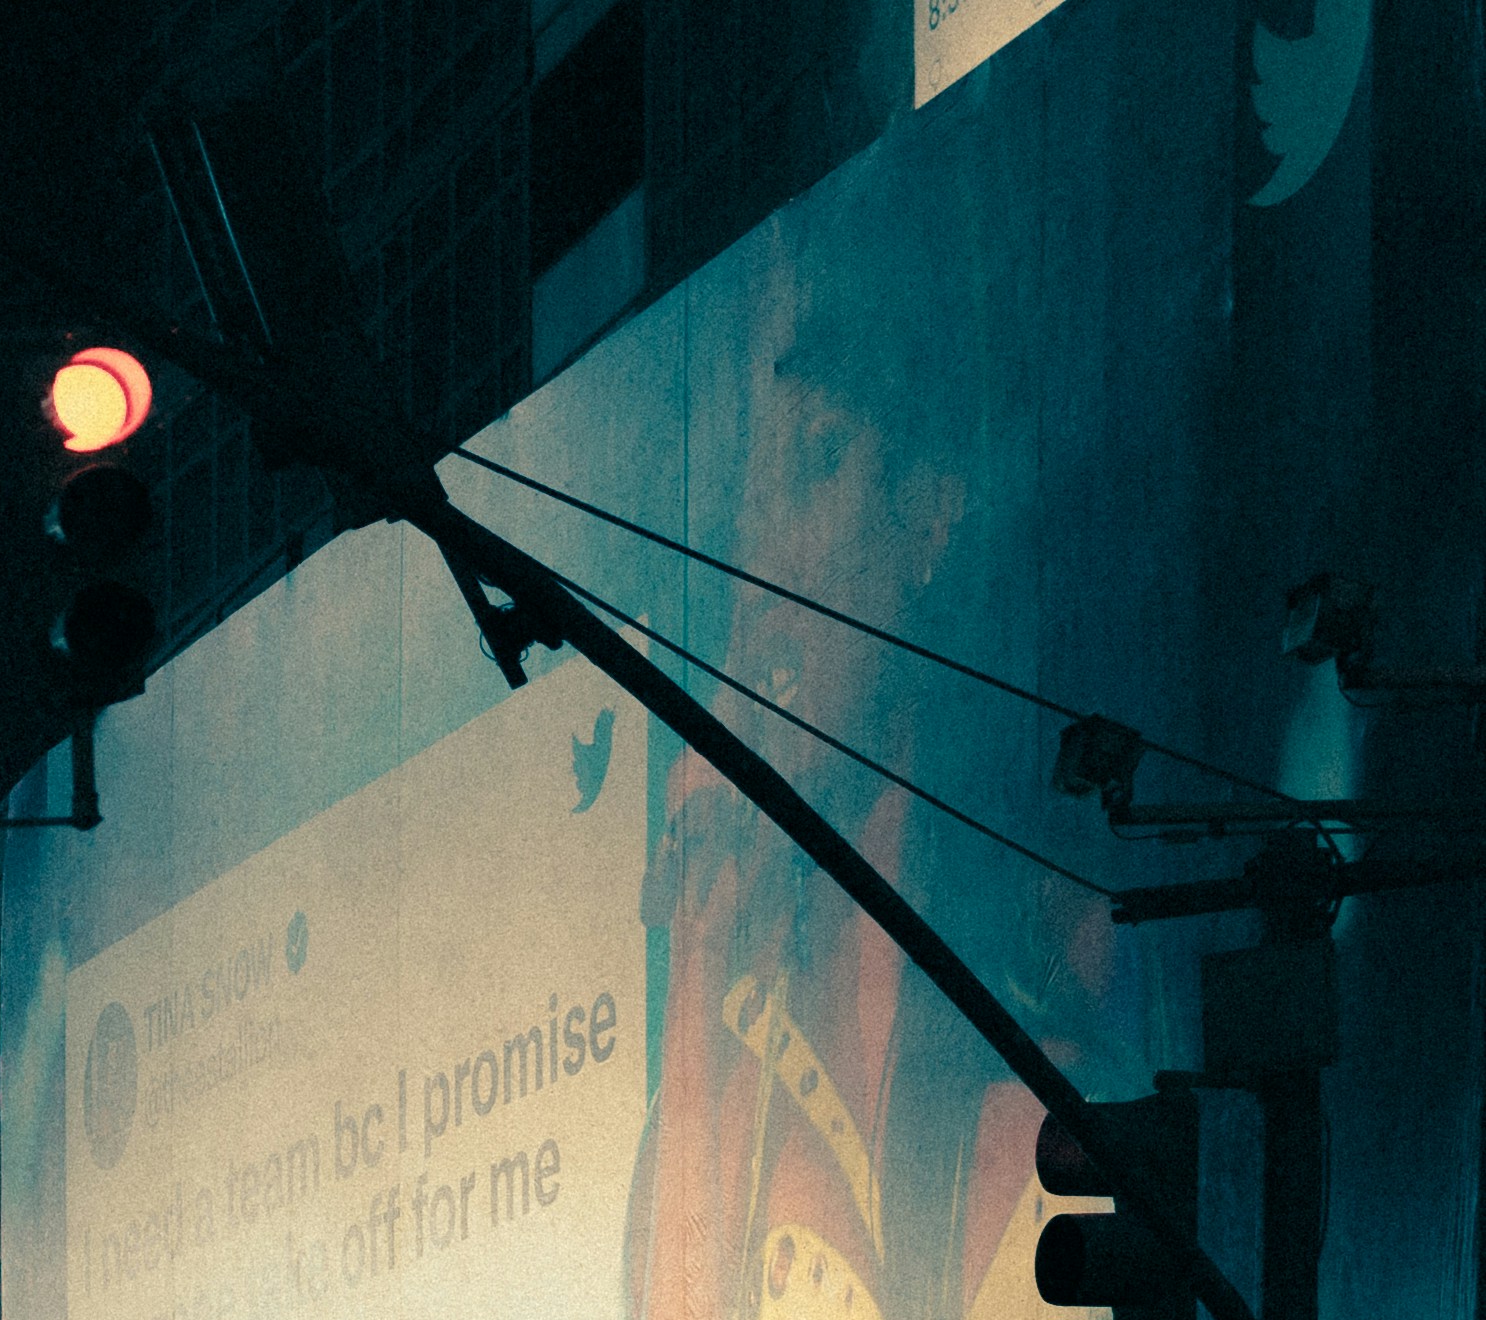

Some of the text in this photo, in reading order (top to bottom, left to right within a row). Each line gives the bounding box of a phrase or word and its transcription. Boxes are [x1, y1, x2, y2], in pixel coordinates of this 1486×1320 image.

[143, 931, 275, 1050] TINA SNOW
[100, 1180, 186, 1293] need
[194, 1187, 218, 1250] a
[226, 1133, 322, 1226] team
[332, 1099, 386, 1180] bc
[398, 1067, 409, 1152] I
[424, 991, 618, 1159] promise
[341, 1185, 402, 1292] off
[414, 1168, 478, 1261] for
[488, 1136, 563, 1230] me
